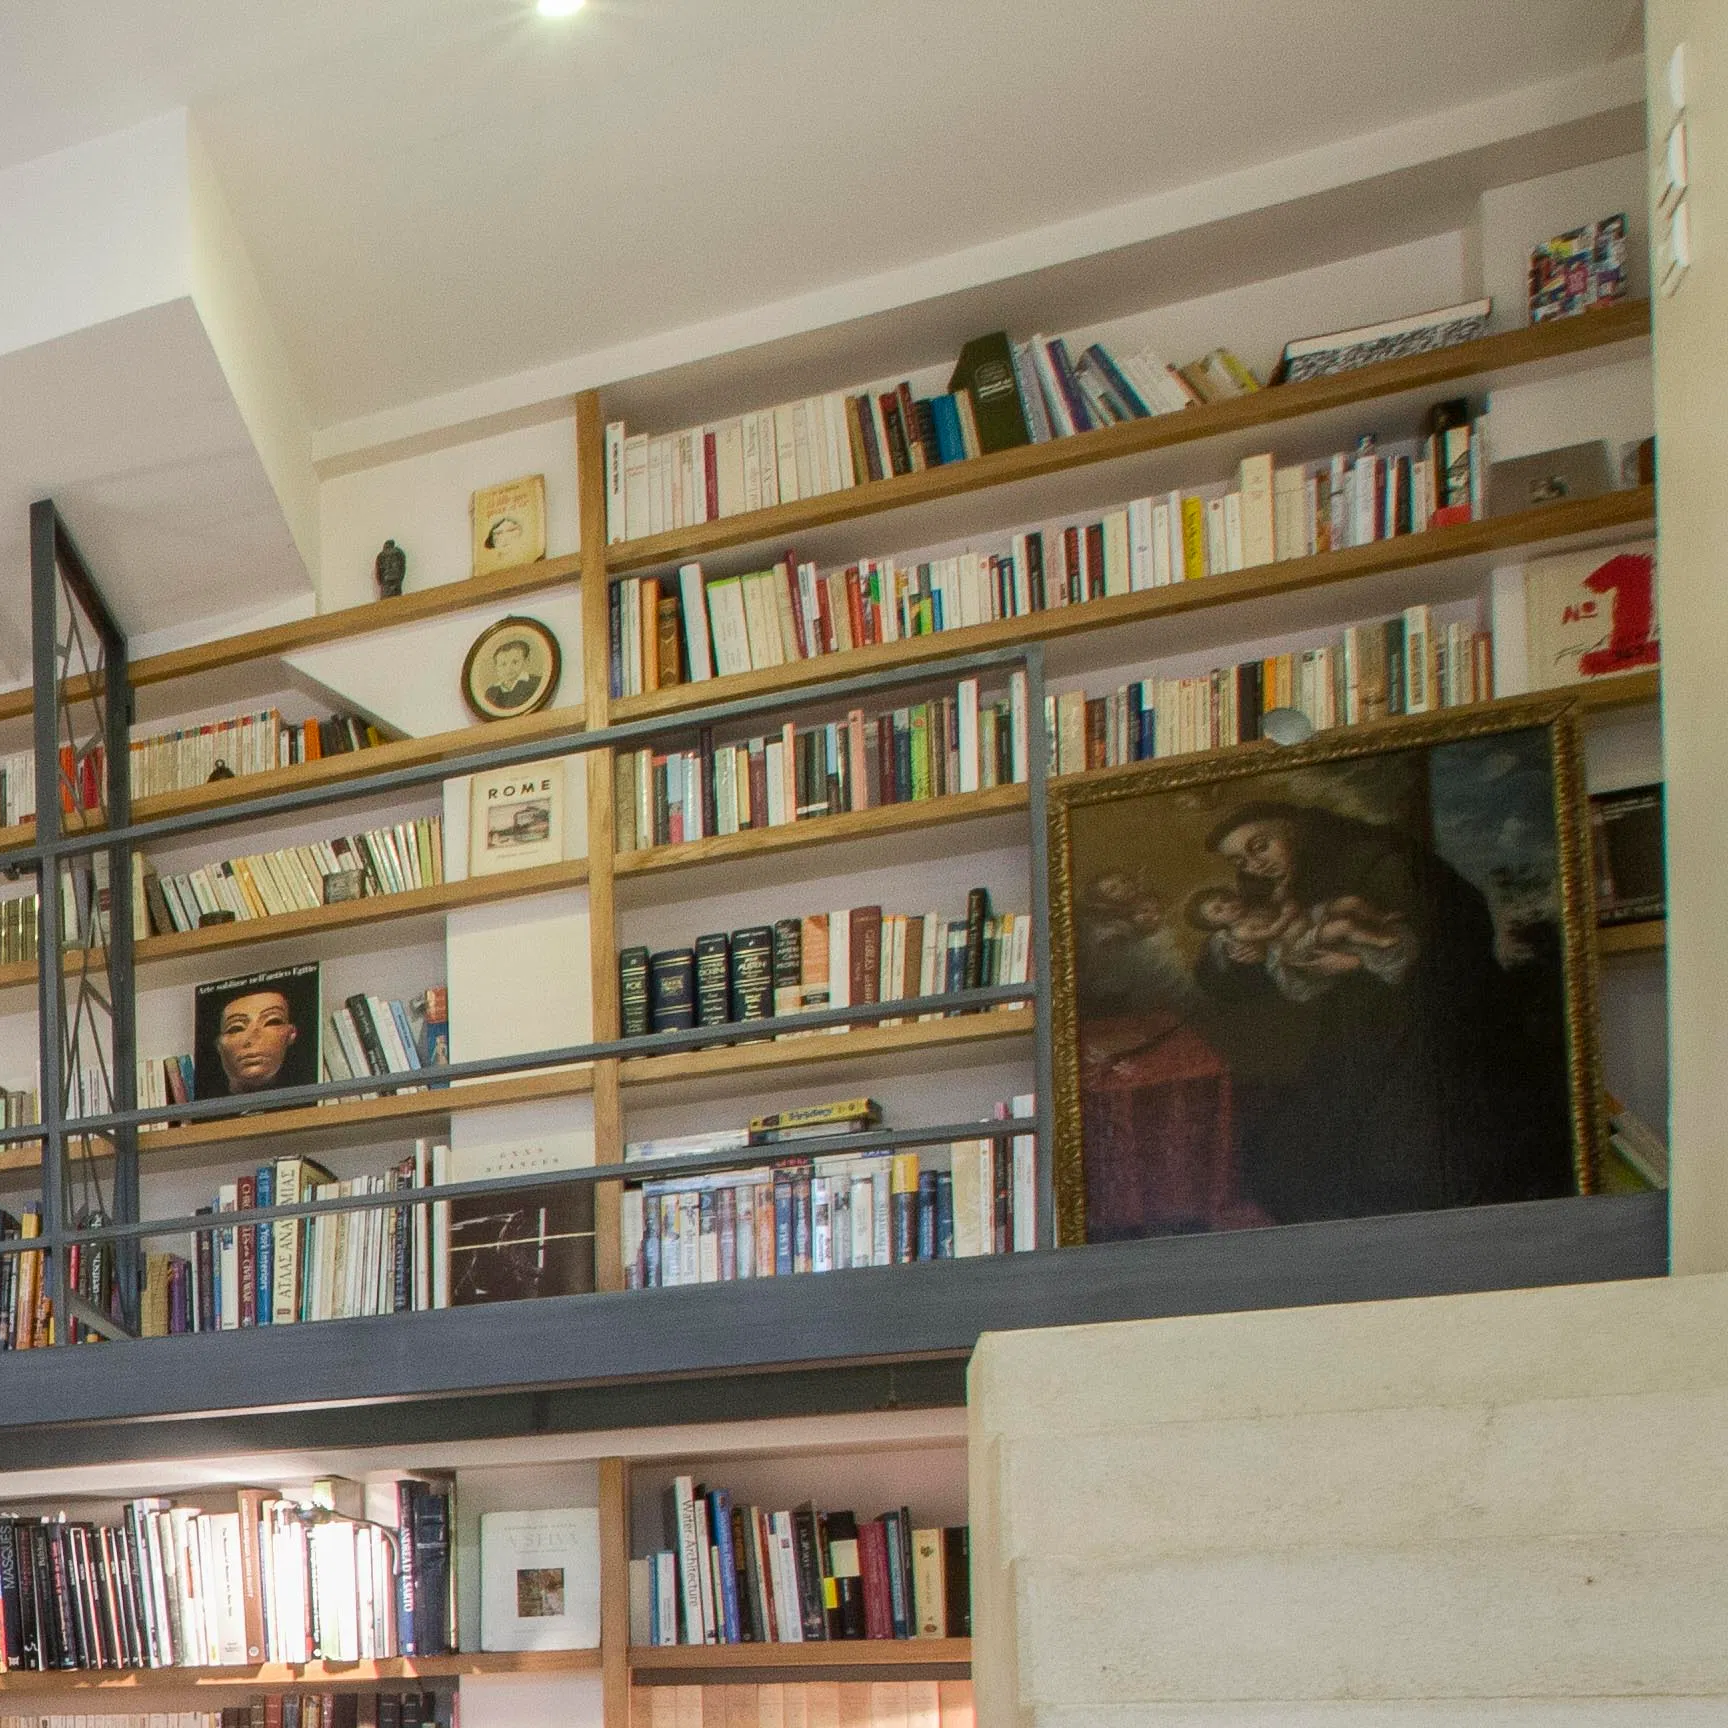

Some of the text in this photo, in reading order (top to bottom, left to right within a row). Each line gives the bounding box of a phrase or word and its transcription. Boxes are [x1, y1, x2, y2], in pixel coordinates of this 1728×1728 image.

[1577, 554, 1661, 676] 1
[488, 780, 551, 800] ROME
[260, 1229, 269, 1290] York Interiors
[0, 1525, 15, 1589] MASQUES
[401, 1525, 413, 1561] ANDREA
[402, 1584, 414, 1612] SARTO
